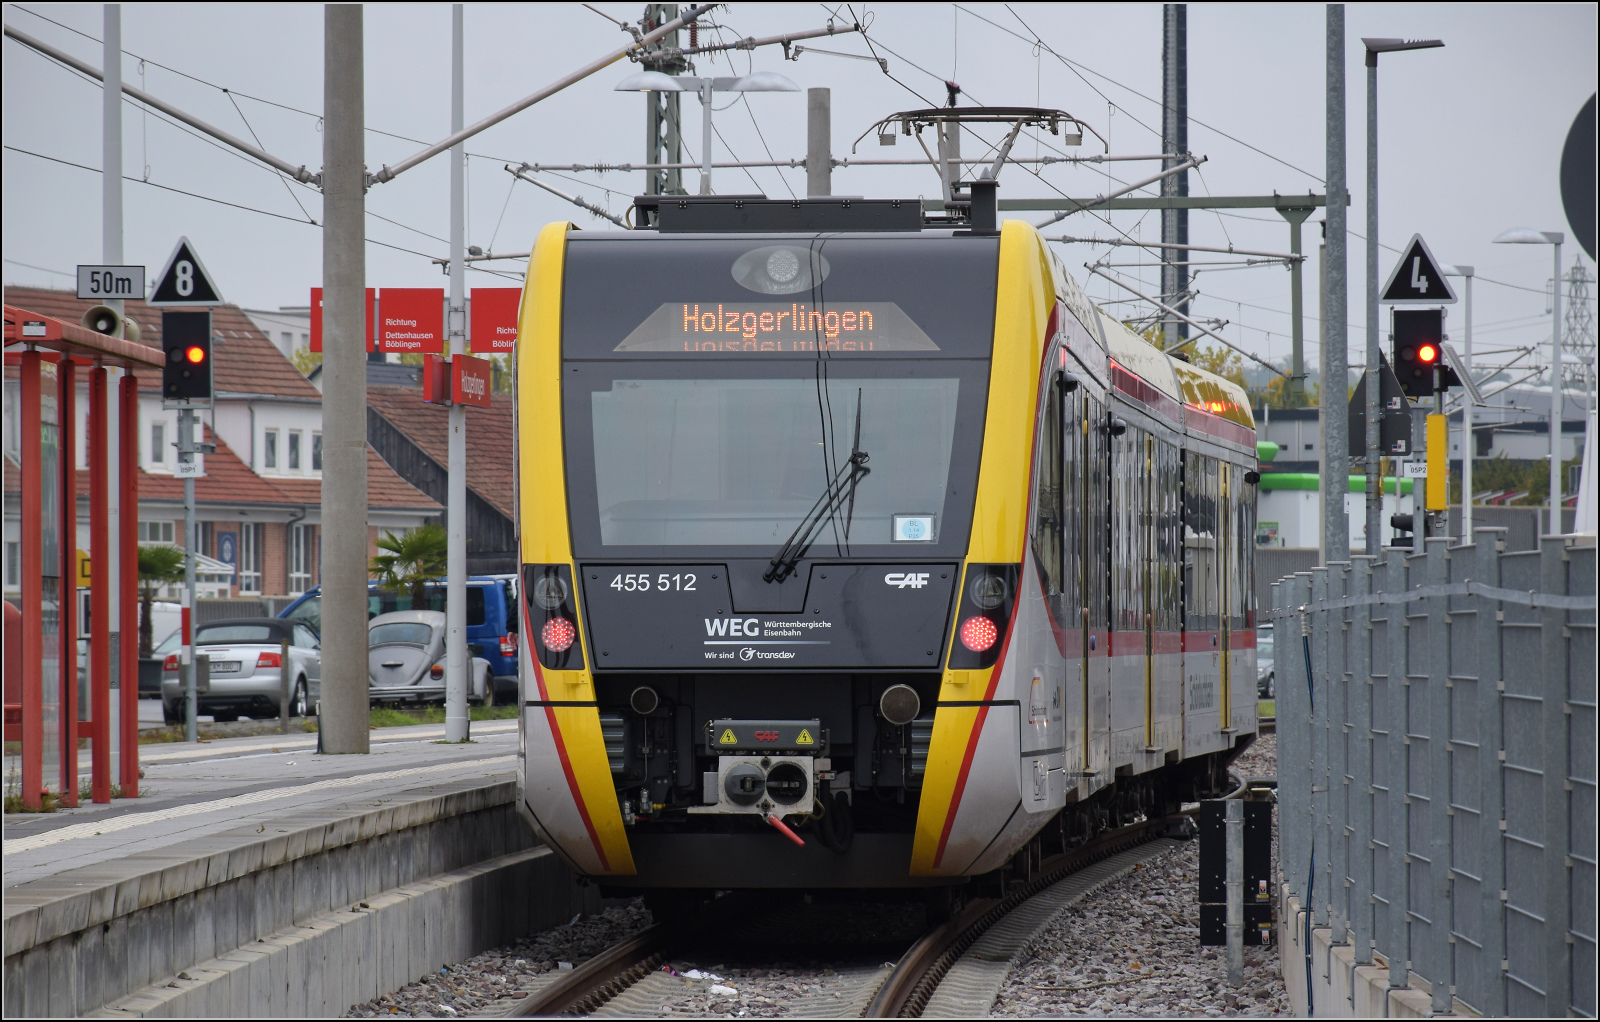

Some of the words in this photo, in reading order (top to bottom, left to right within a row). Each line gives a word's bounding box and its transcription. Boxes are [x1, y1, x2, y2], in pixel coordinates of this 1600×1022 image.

[175, 260, 194, 297] 8
[1411, 256, 1429, 293] 4
[90, 271, 132, 294] 50m
[385, 318, 417, 327] Richtung
[683, 303, 873, 338] Holzgerlingen
[385, 331, 433, 339] Dettenhausen
[385, 340, 421, 349] Böblingen
[610, 573, 650, 591] 455
[657, 573, 697, 591] 512
[884, 572, 930, 589] CAF
[704, 618, 760, 637] WEG
[763, 620, 832, 629] Württembergische
[763, 629, 802, 637] Eisenbahn
[704, 651, 717, 659] Wir
[718, 651, 735, 659] sind
[756, 650, 796, 659] transdev
[753, 731, 780, 742] CAF
